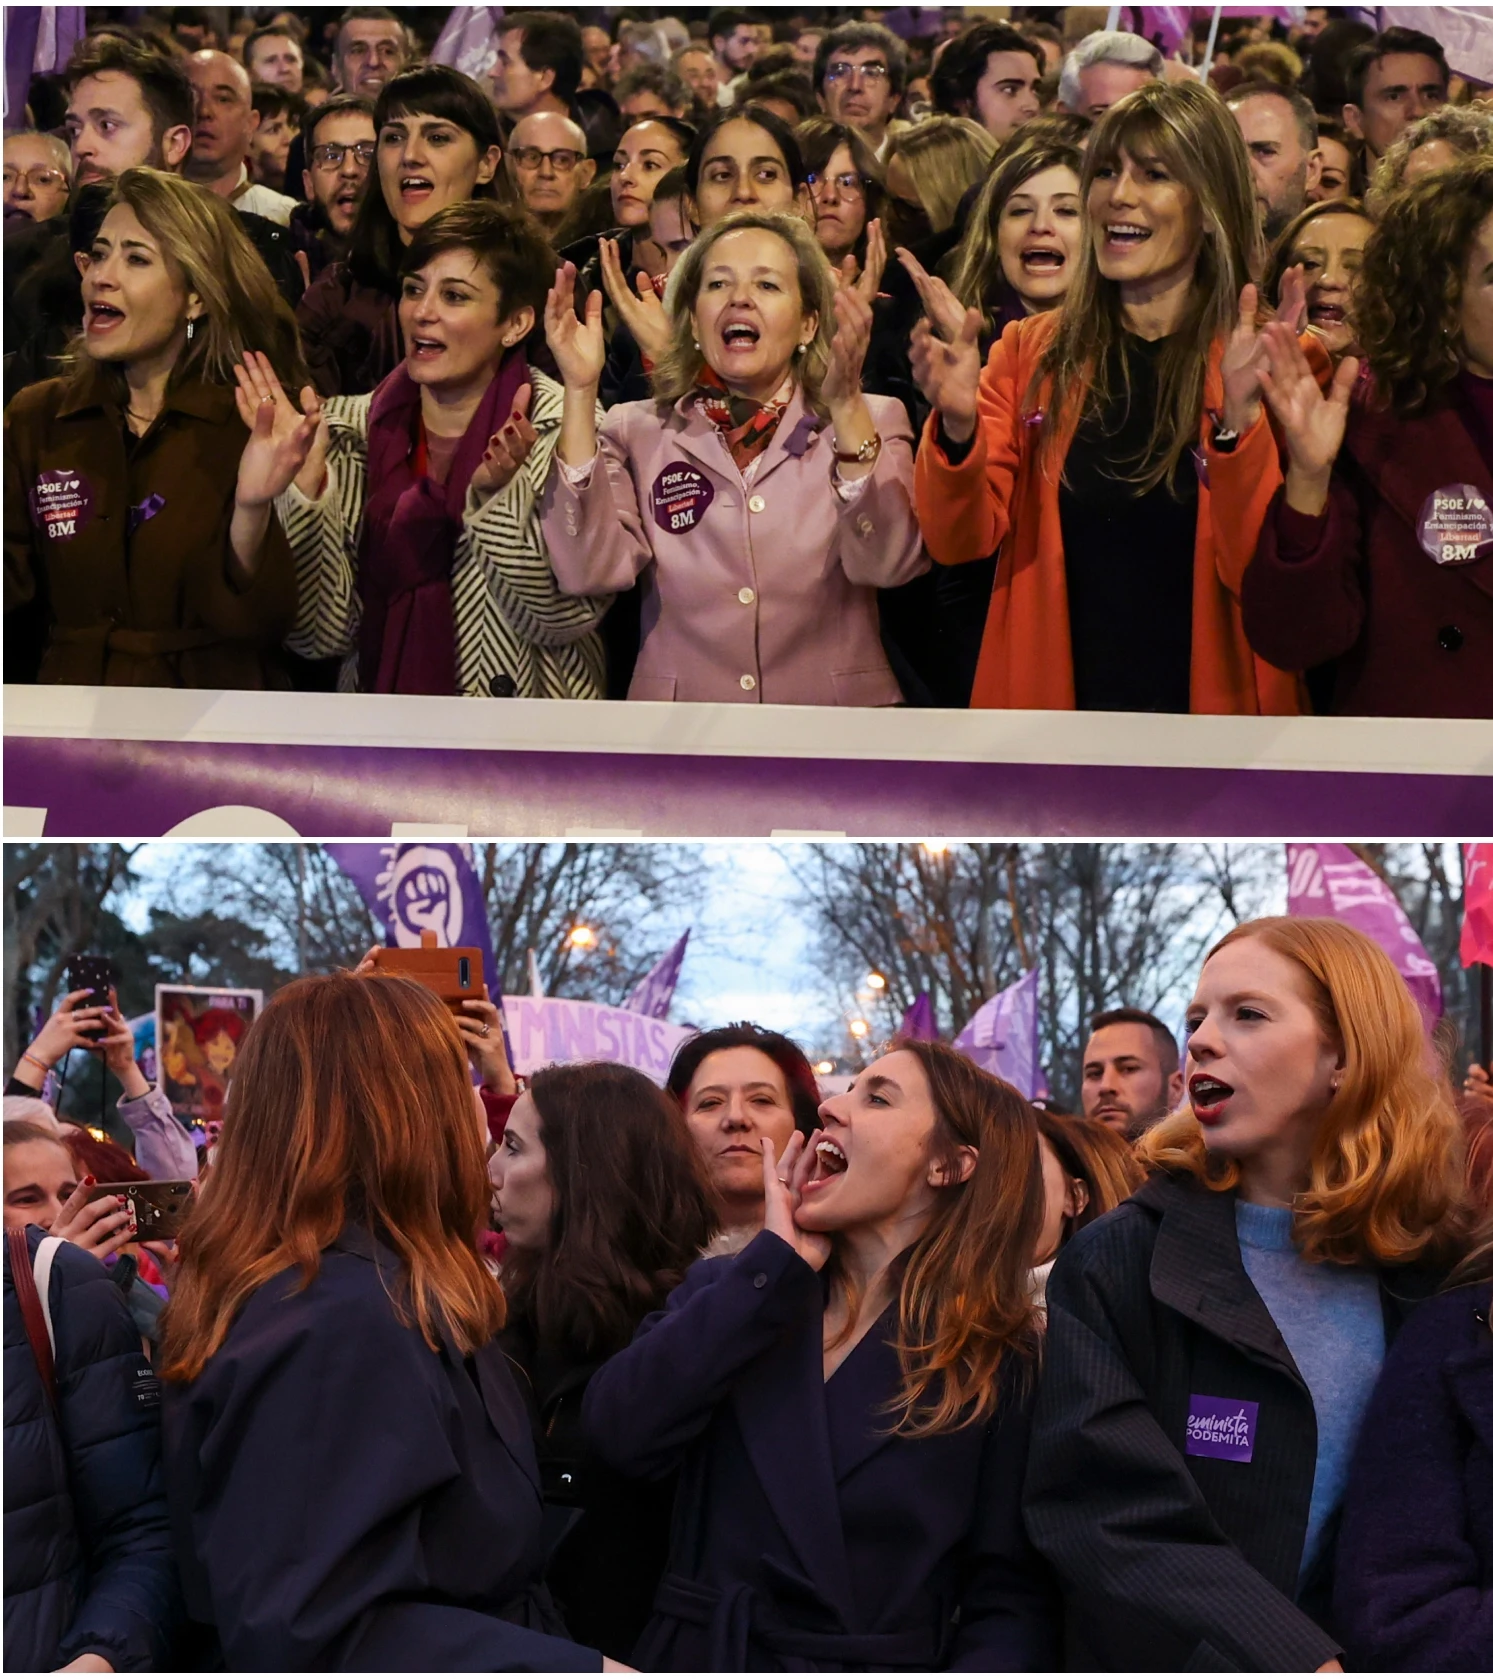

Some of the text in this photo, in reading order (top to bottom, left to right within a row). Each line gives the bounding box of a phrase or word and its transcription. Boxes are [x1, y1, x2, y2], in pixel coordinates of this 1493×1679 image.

[662, 472, 683, 486] PSOE
[37, 482, 62, 495] PSOE
[1434, 498, 1464, 510] PSOE
[671, 509, 695, 529] 8M
[1434, 511, 1485, 521] Feminismo,
[48, 520, 76, 538] 8M
[1424, 521, 1487, 530] Emancipación
[1441, 544, 1478, 561] 8M
[1187, 1408, 1249, 1437] eminista
[1186, 1428, 1249, 1447] PODEMITA
